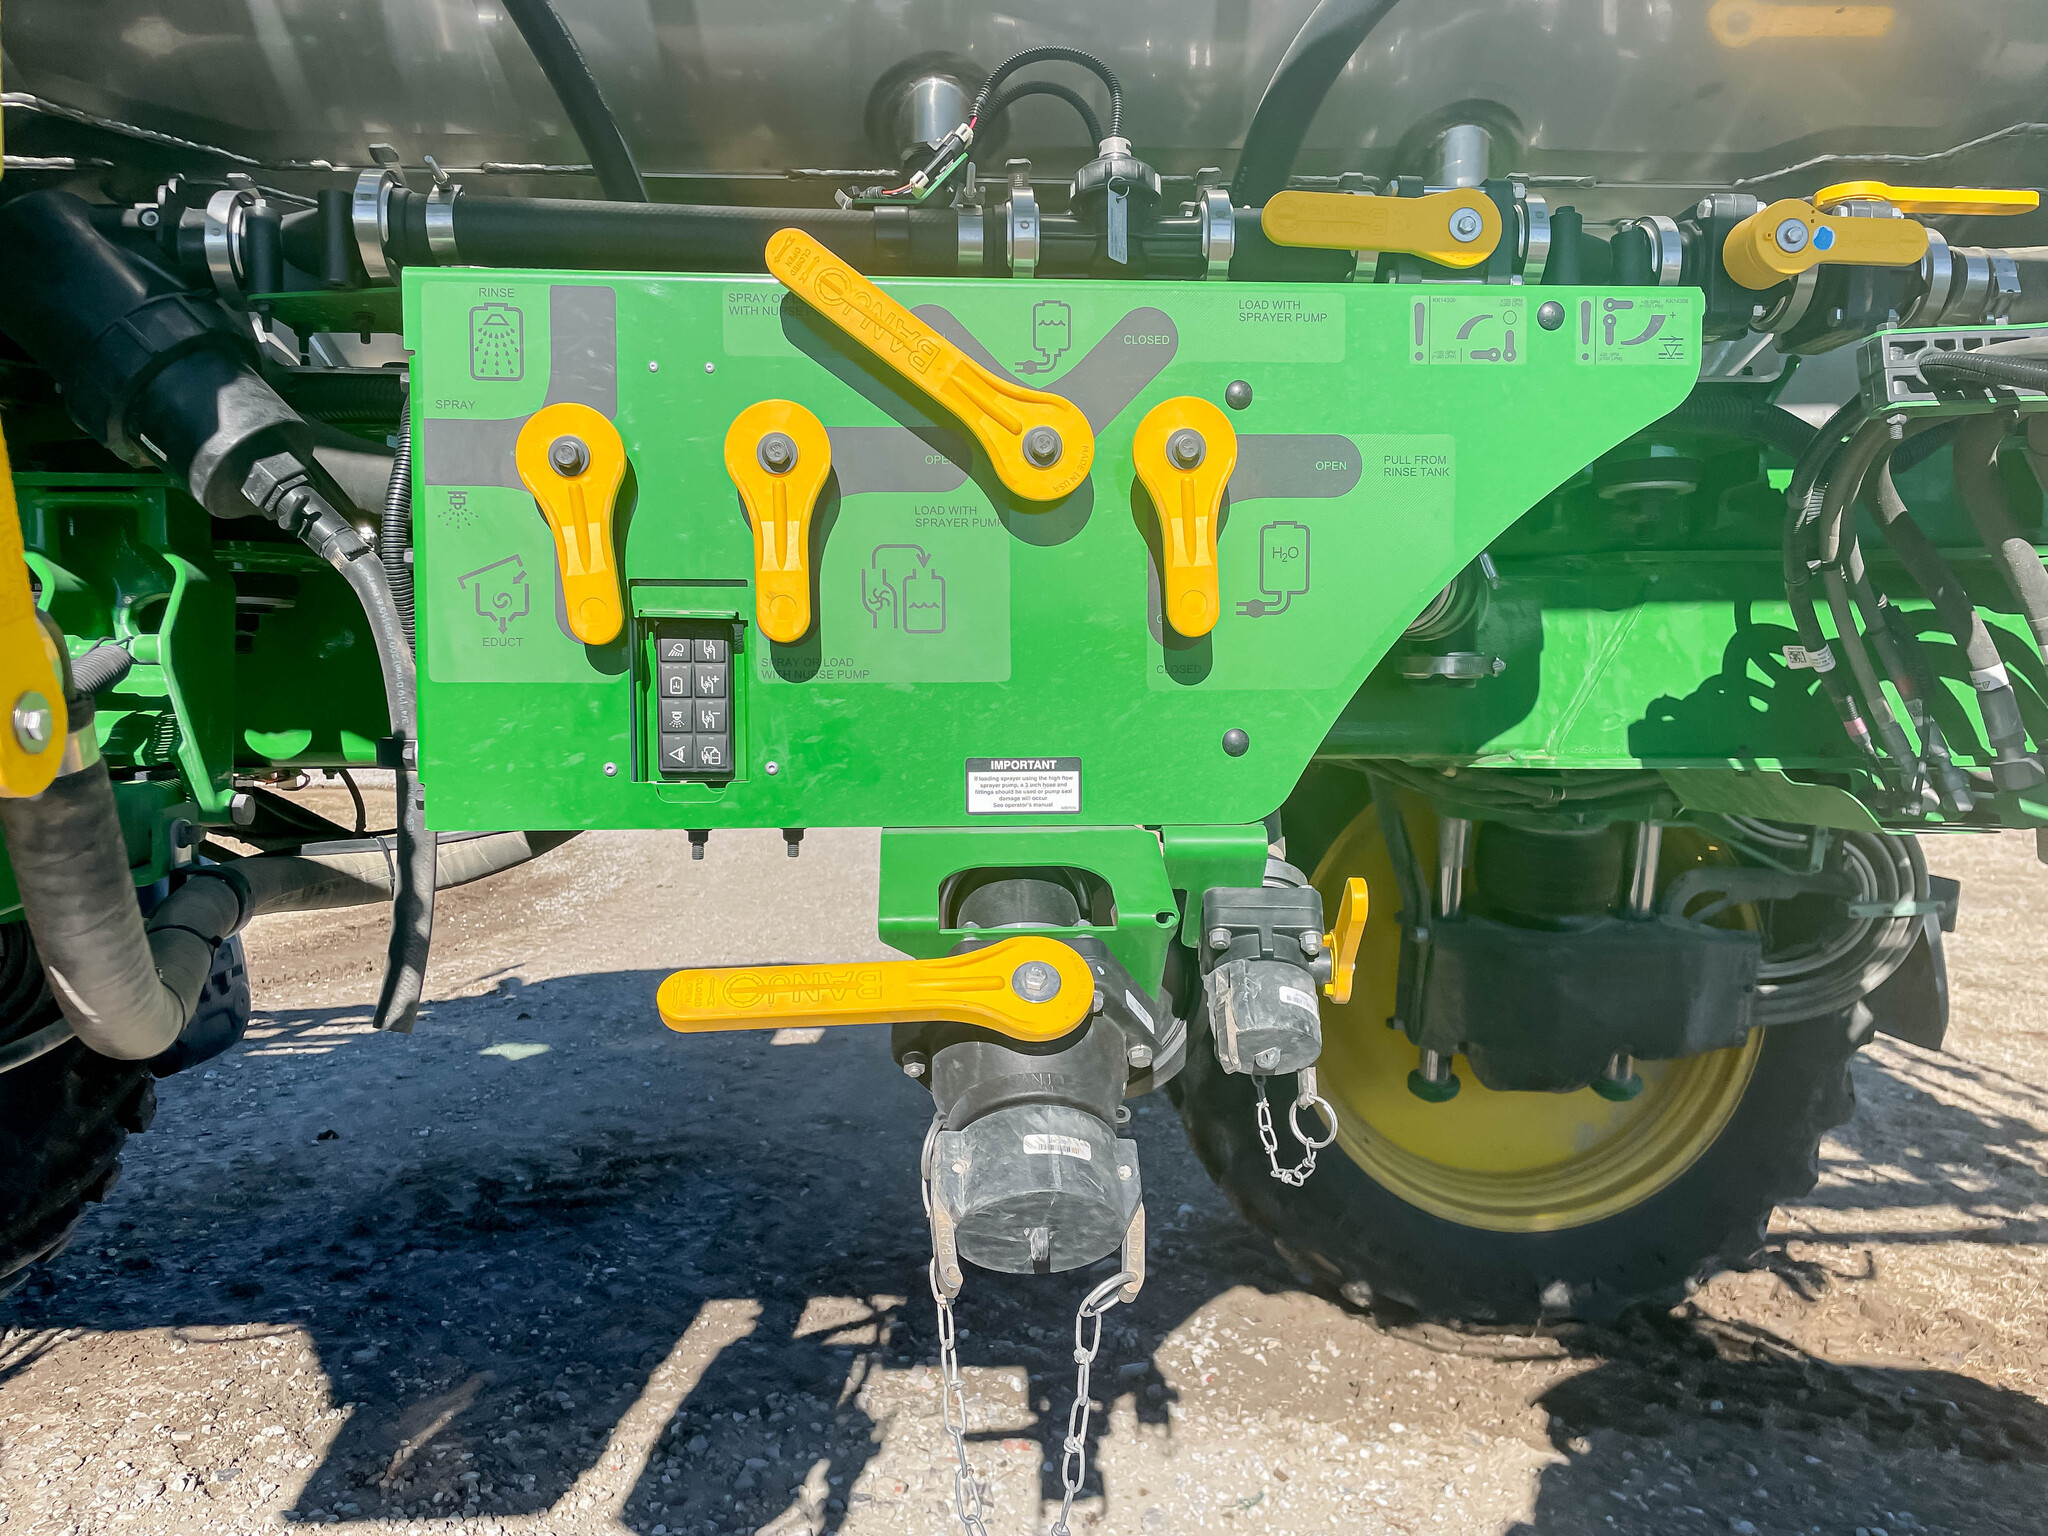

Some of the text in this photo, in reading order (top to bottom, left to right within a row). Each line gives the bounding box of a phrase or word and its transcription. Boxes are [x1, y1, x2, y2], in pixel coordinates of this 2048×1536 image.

[478, 287, 515, 298] RINSE
[728, 292, 768, 304] SPRAY
[1238, 299, 1301, 310] LOAD WITH
[729, 305, 759, 316] WITH
[762, 305, 803, 316] NURSE
[814, 267, 942, 374] BANJO
[1238, 312, 1328, 323] SPRAYER PUMP
[1123, 334, 1170, 346] CLOSED
[435, 399, 476, 411] SPRAY
[1383, 455, 1447, 465] PULL FROM
[1052, 445, 1090, 493] MADE IN USA
[1315, 461, 1347, 471] OPEN
[1383, 467, 1450, 477] RINSE TANK
[914, 505, 977, 516] LOAD WITH
[915, 518, 969, 528] SPRAYER
[482, 637, 524, 648] EDUCT
[761, 657, 854, 668] SPRAY OR LOAD
[761, 669, 870, 680] WITH NURSE PUMP
[1156, 664, 1202, 675] CLOSED
[990, 760, 1057, 770] IMPORTANT
[978, 775, 999, 783] loading
[1000, 775, 1021, 783] sprayer
[1022, 775, 1038, 783] using
[1038, 775, 1047, 783] the
[1048, 775, 1061, 783] high
[723, 969, 883, 1008] BANJO
